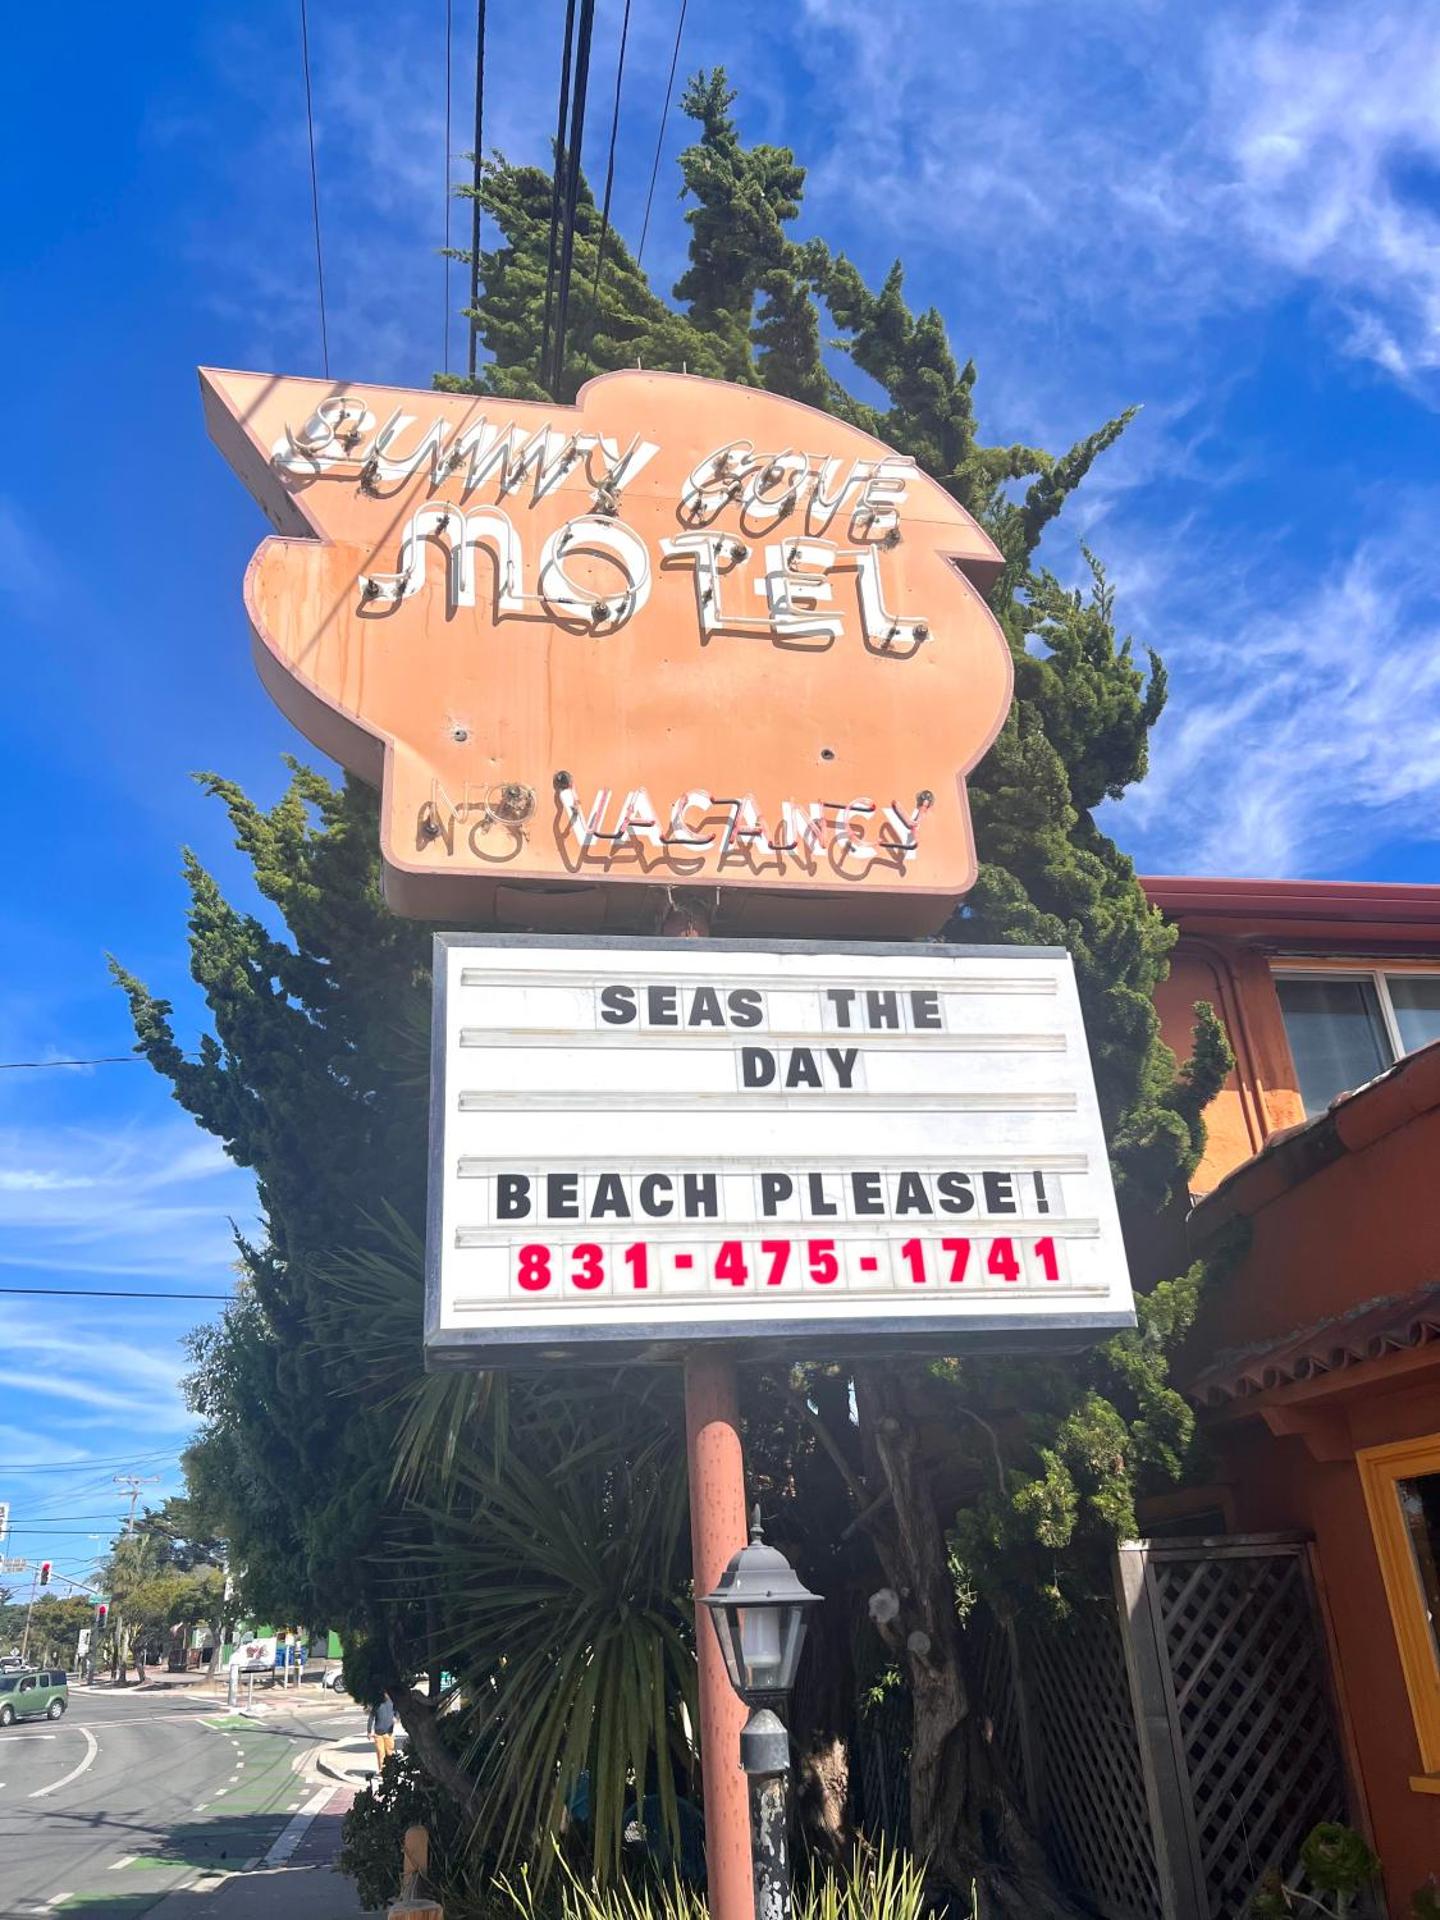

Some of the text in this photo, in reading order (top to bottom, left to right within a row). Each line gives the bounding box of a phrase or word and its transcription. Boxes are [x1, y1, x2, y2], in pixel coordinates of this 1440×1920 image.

[271, 396, 921, 532] SUNNY COVE
[358, 500, 933, 642] MOTEL
[427, 777, 934, 861] NO VACANCY
[601, 985, 942, 1029] SEAS THE
[741, 1046, 860, 1089] DAY
[496, 1170, 1049, 1219] BEACH PLEASE!
[517, 1235, 1060, 1292] 831-475-1741
